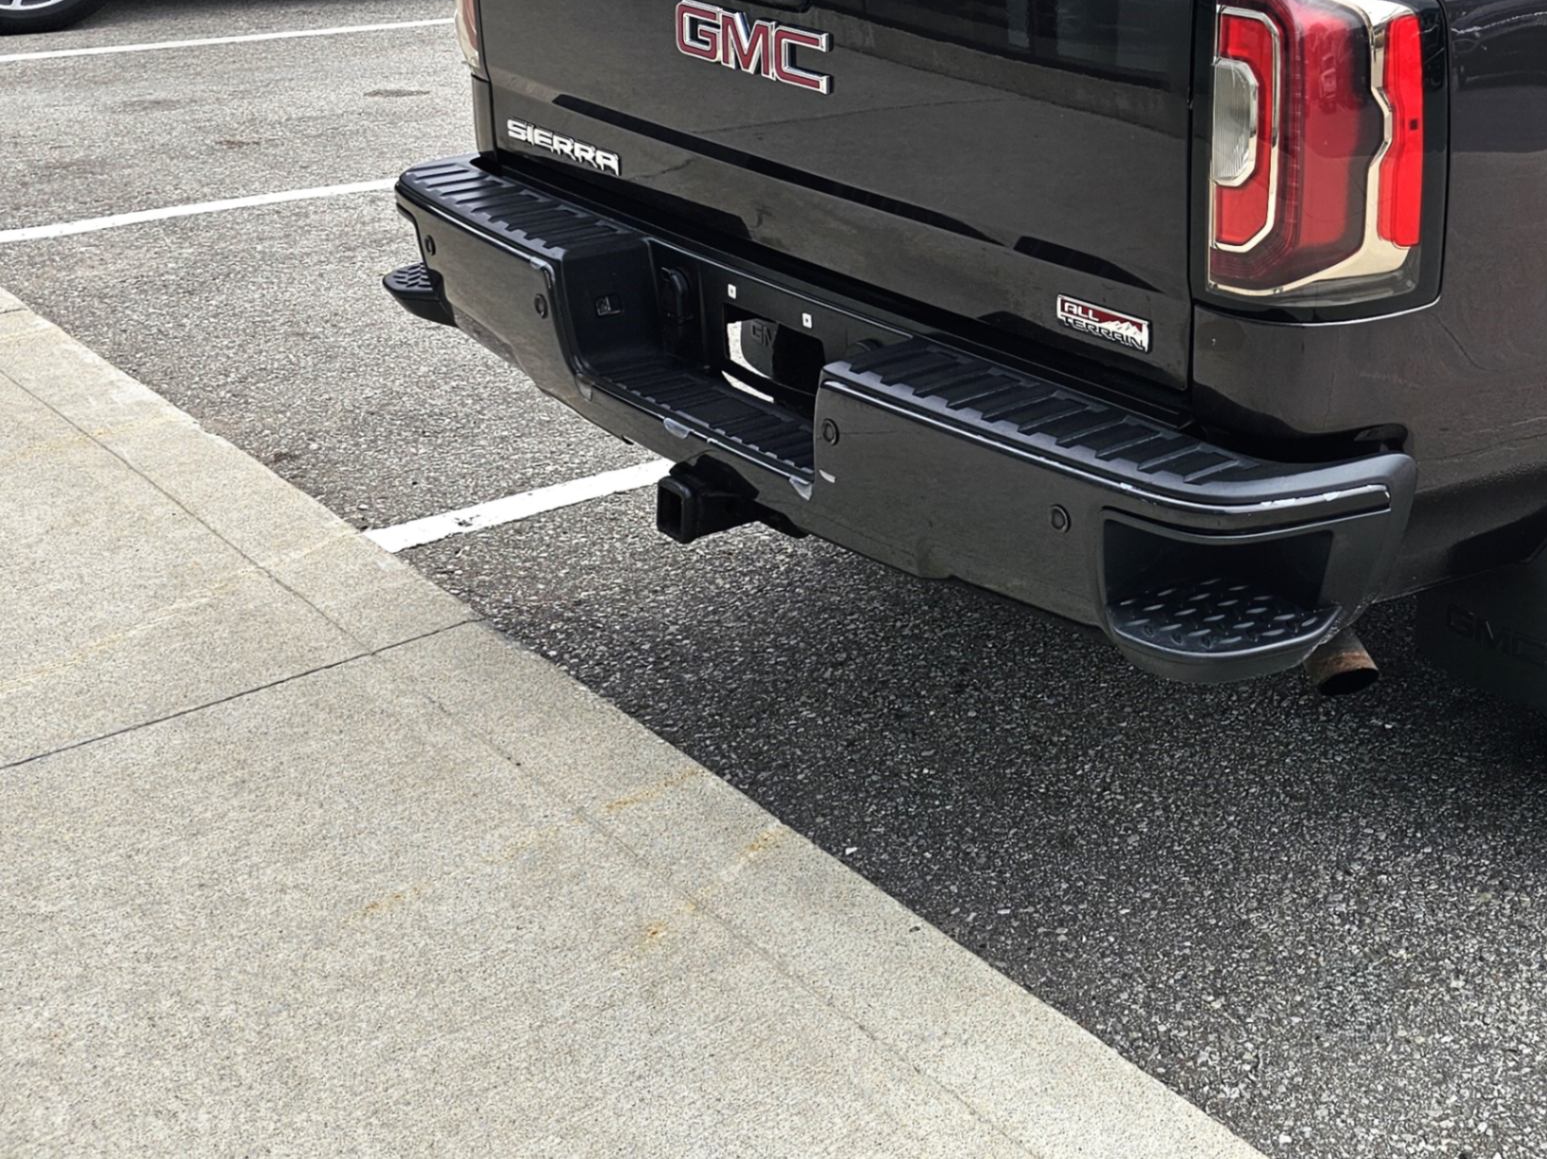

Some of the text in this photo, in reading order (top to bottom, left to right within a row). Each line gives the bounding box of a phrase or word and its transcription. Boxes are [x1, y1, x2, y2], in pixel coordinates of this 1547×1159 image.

[507, 119, 620, 177] SIERRA
[1064, 301, 1100, 322] ALL
[1063, 316, 1144, 351] TERRAIN
